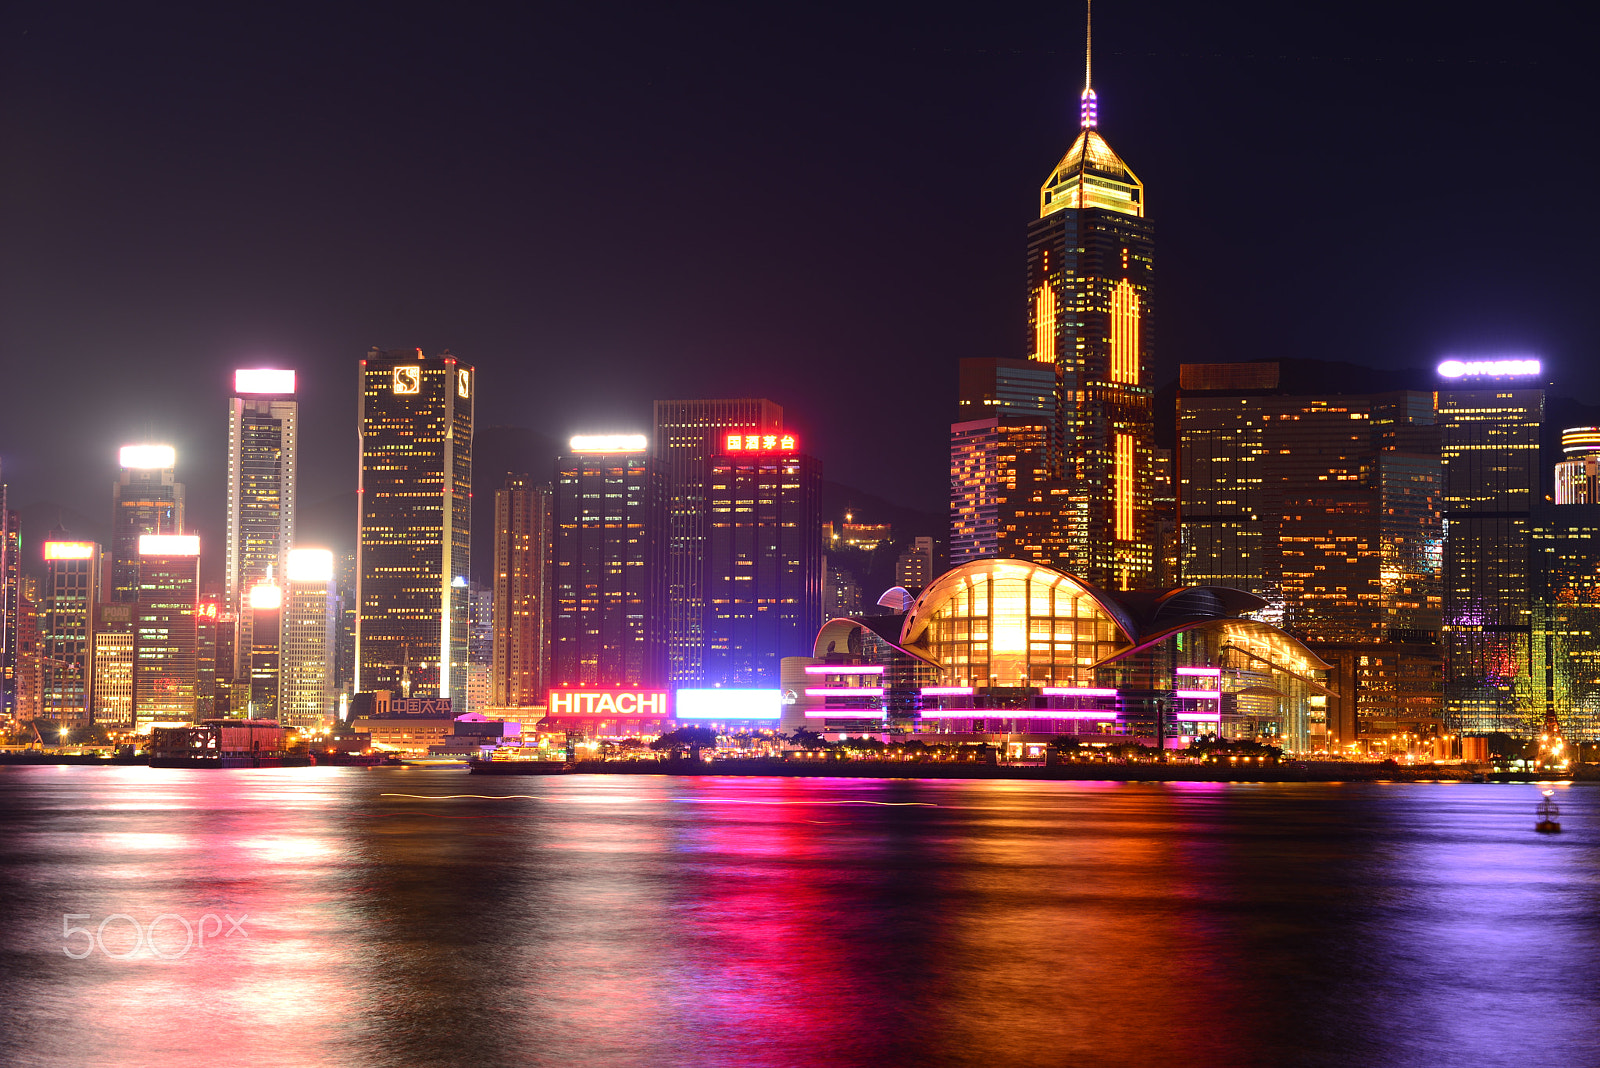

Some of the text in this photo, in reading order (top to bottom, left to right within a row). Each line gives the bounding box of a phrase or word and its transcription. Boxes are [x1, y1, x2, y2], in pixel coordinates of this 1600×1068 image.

[727, 434, 795, 450] 国酒茅台
[104, 607, 129, 617] POAD
[391, 697, 451, 714] 中国太平
[551, 692, 667, 714] HITACHI
